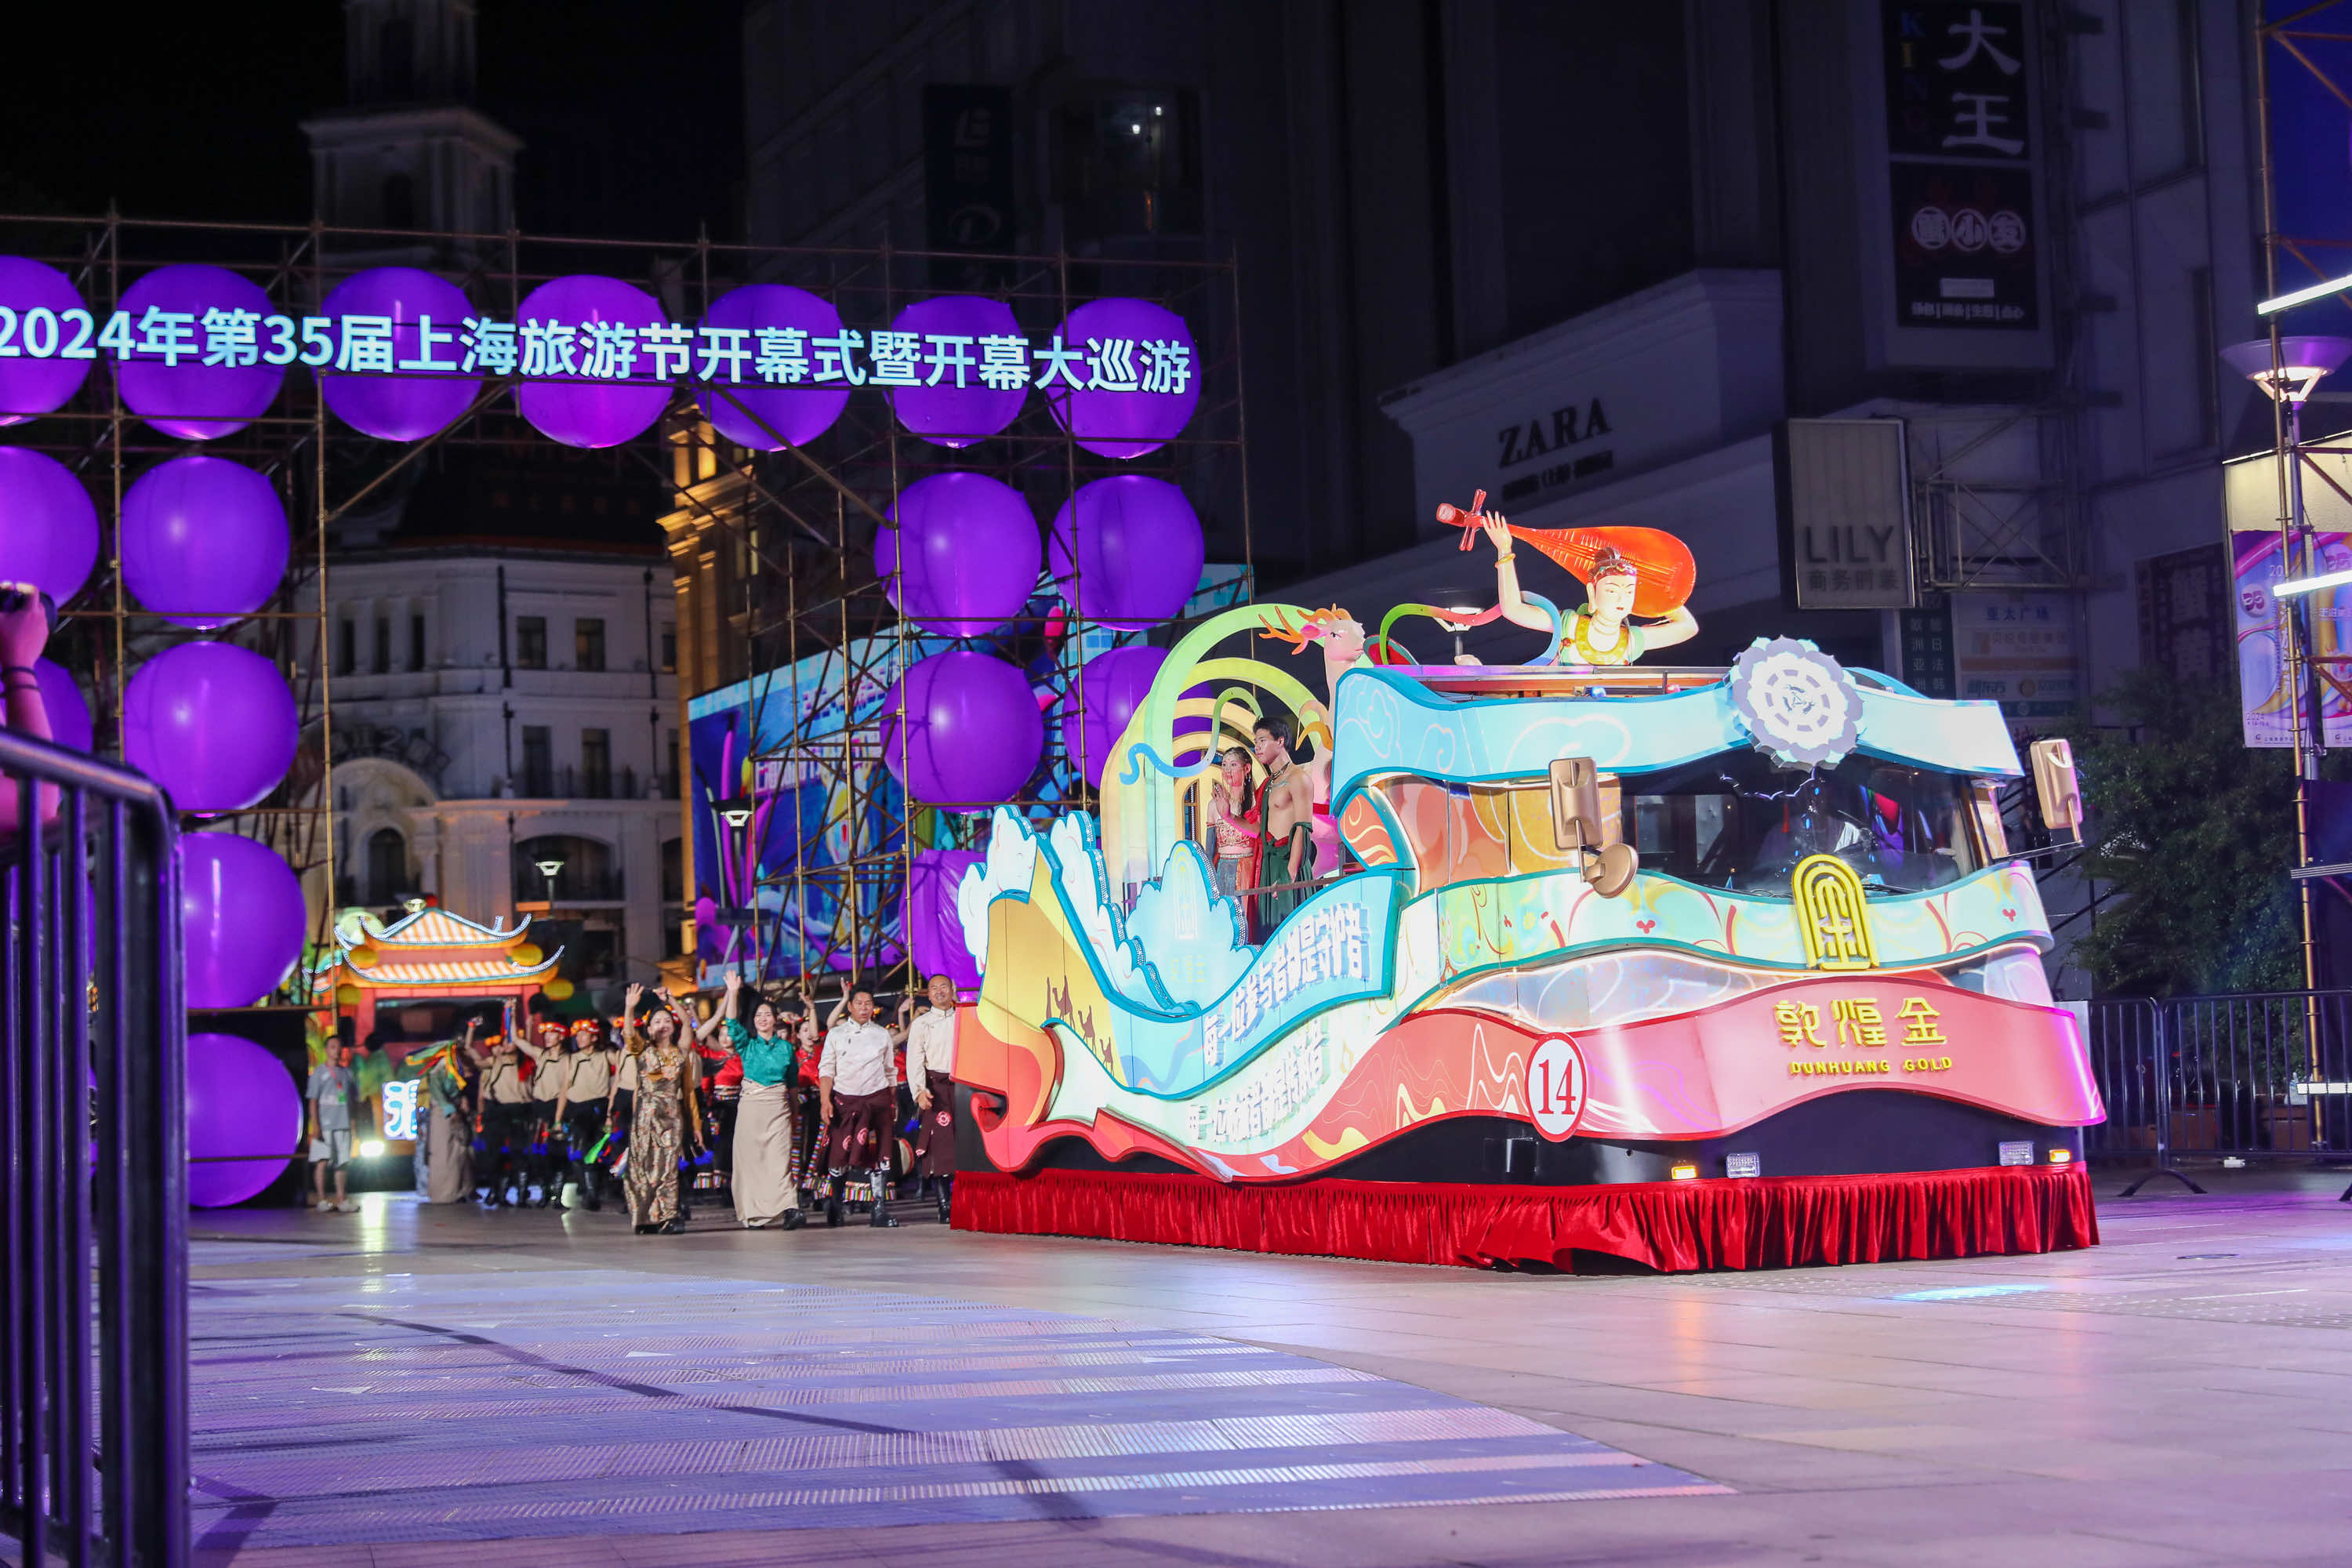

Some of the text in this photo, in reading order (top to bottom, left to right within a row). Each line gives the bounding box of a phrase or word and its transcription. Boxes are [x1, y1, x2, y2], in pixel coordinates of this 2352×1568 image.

[1937, 8, 2026, 154] 大王
[0, 306, 1192, 394] 2024年第35届上海旅游节开幕式暨开幕大巡游
[1498, 397, 1612, 469] ZARA
[1805, 526, 1894, 563] LILY
[1774, 996, 1947, 1048] 敦煌金
[1537, 1057, 1577, 1116] 14
[1789, 1056, 1953, 1075] DUNHUANG GOLD
